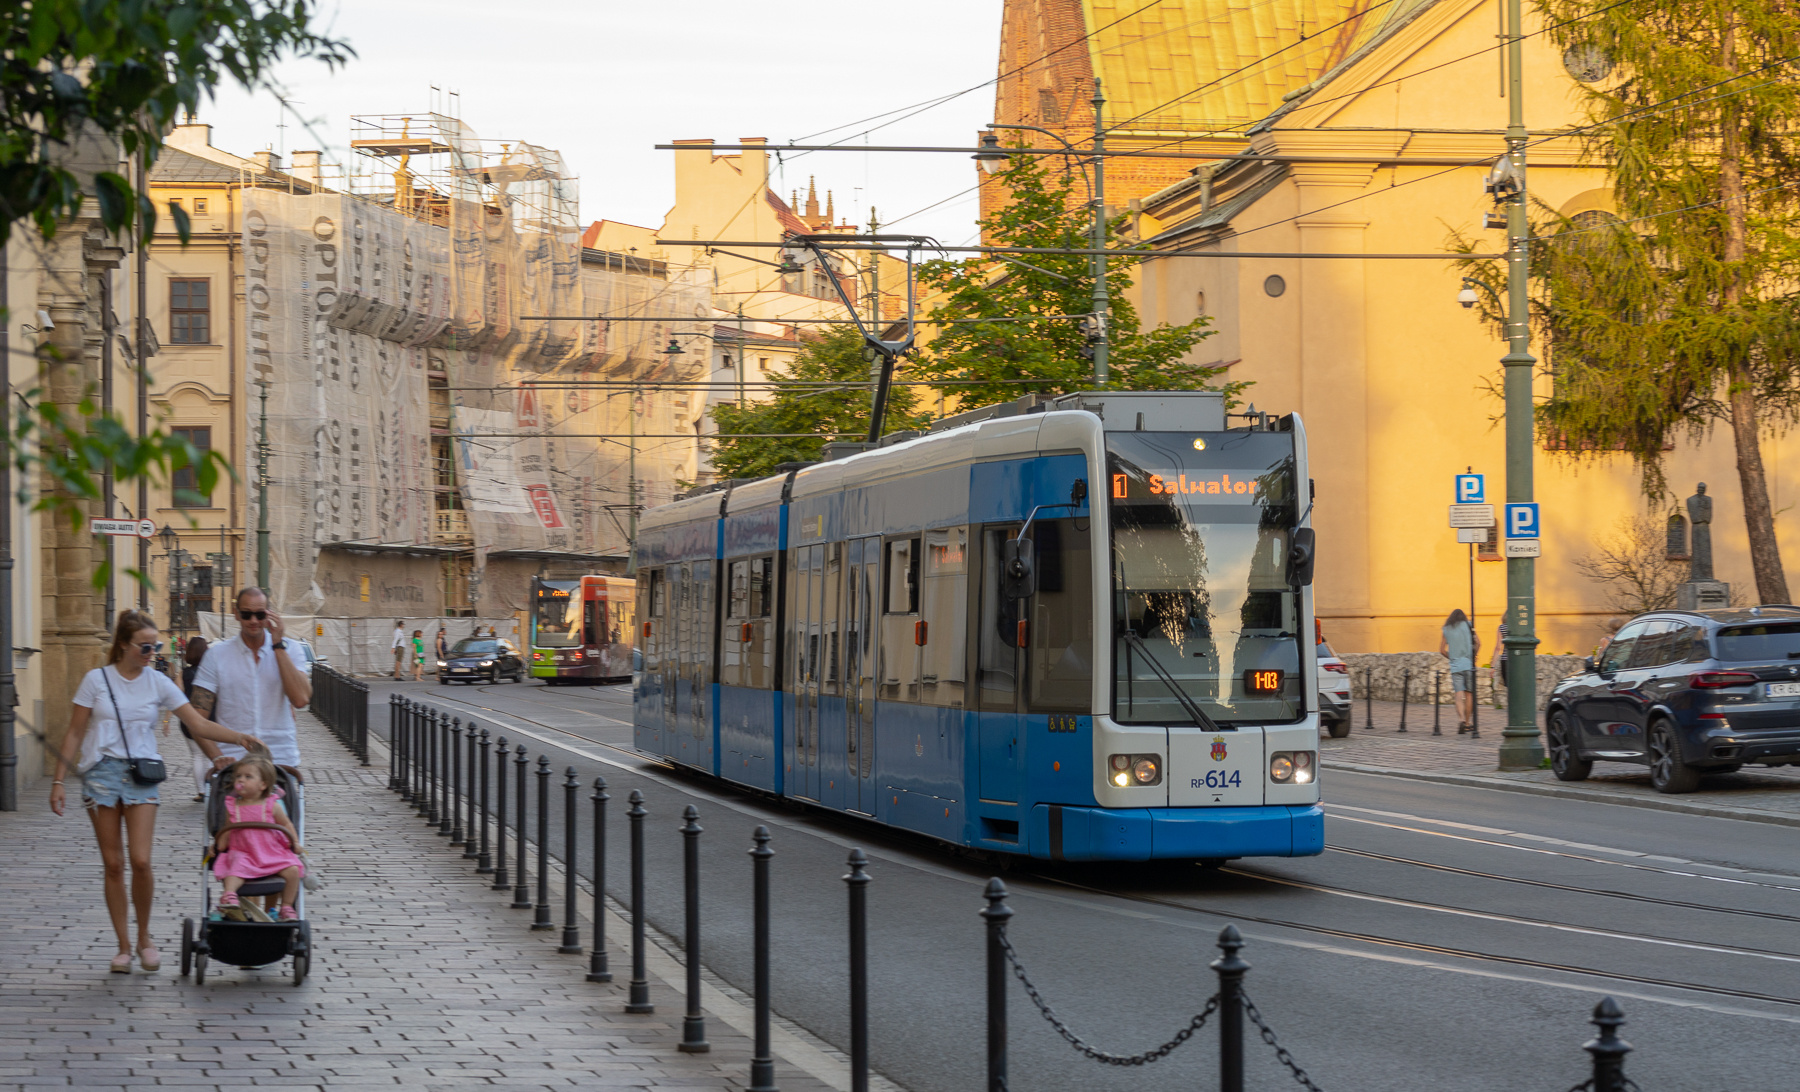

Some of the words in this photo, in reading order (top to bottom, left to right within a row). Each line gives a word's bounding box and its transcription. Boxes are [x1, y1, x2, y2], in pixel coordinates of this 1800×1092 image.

[247, 209, 273, 389] OPTOLITH
[1114, 475, 1126, 497] 1
[1150, 474, 1258, 495] Salwator
[1460, 477, 1480, 501] P
[1511, 507, 1534, 535] P
[1254, 672, 1278, 689] 1-03
